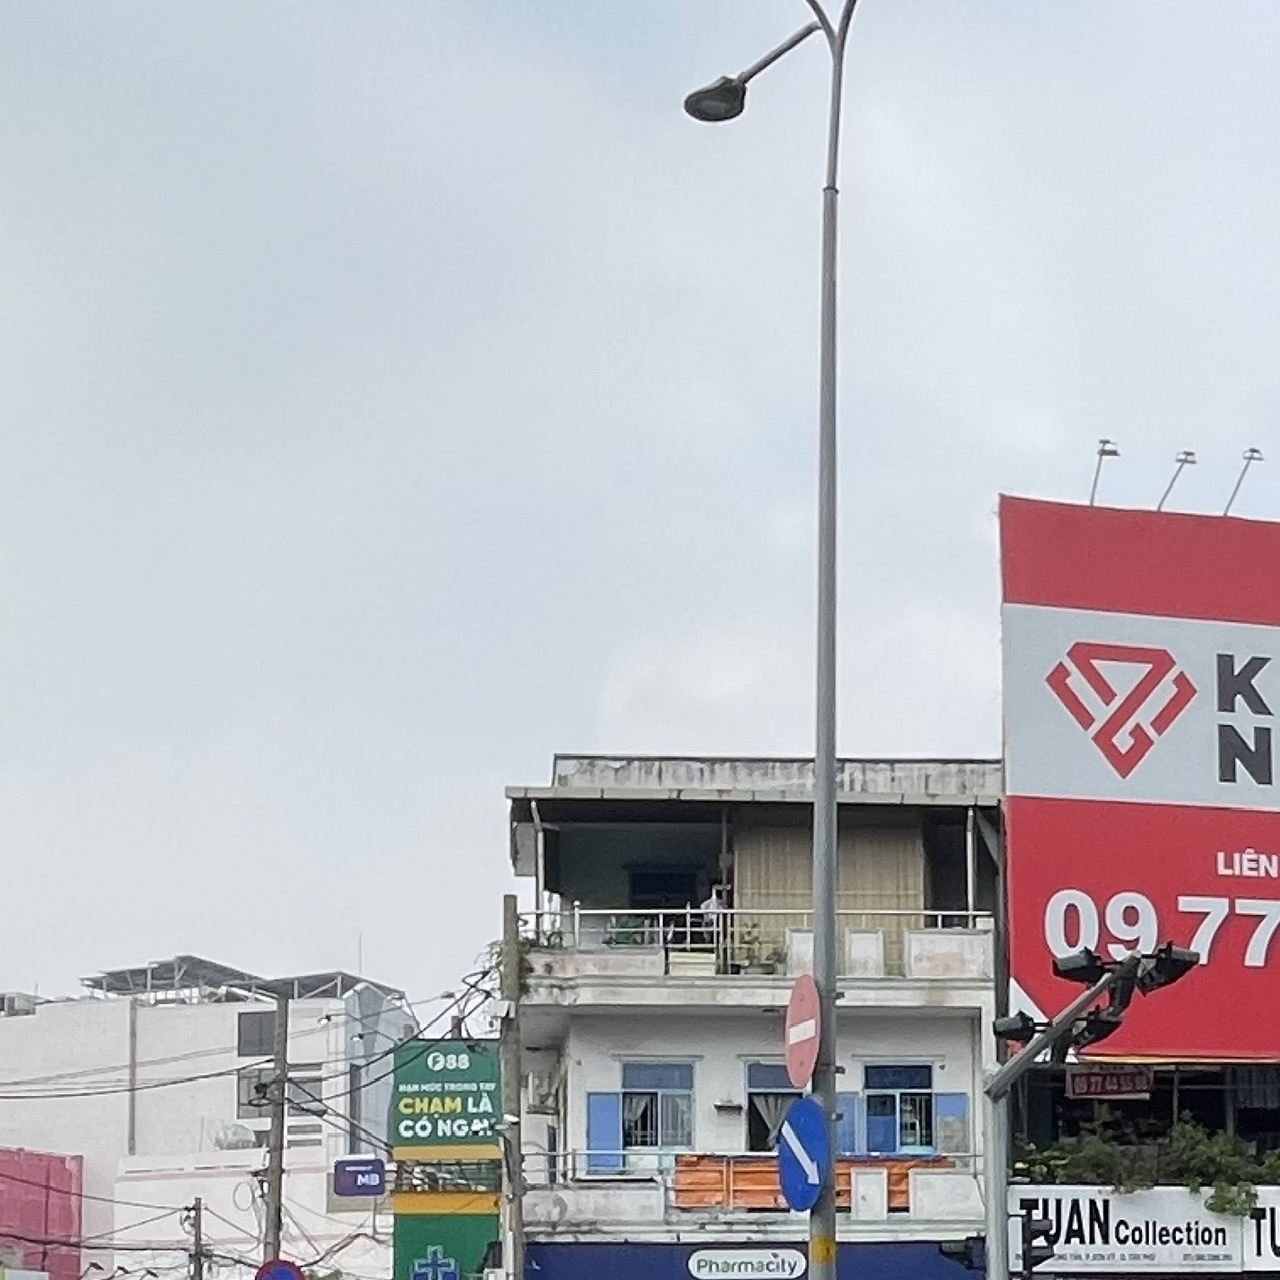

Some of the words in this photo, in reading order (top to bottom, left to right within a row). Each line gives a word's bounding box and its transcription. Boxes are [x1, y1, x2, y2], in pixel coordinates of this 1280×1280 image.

[1216, 848, 1278, 878] LIÊN
[1044, 889, 1159, 962] 09
[398, 1096, 462, 1118] CHẠM
[467, 1091, 493, 1113] LÀ
[398, 1115, 432, 1137] CÓ
[1115, 1219, 1227, 1246] Collection
[696, 1252, 798, 1276] Pharmacity
